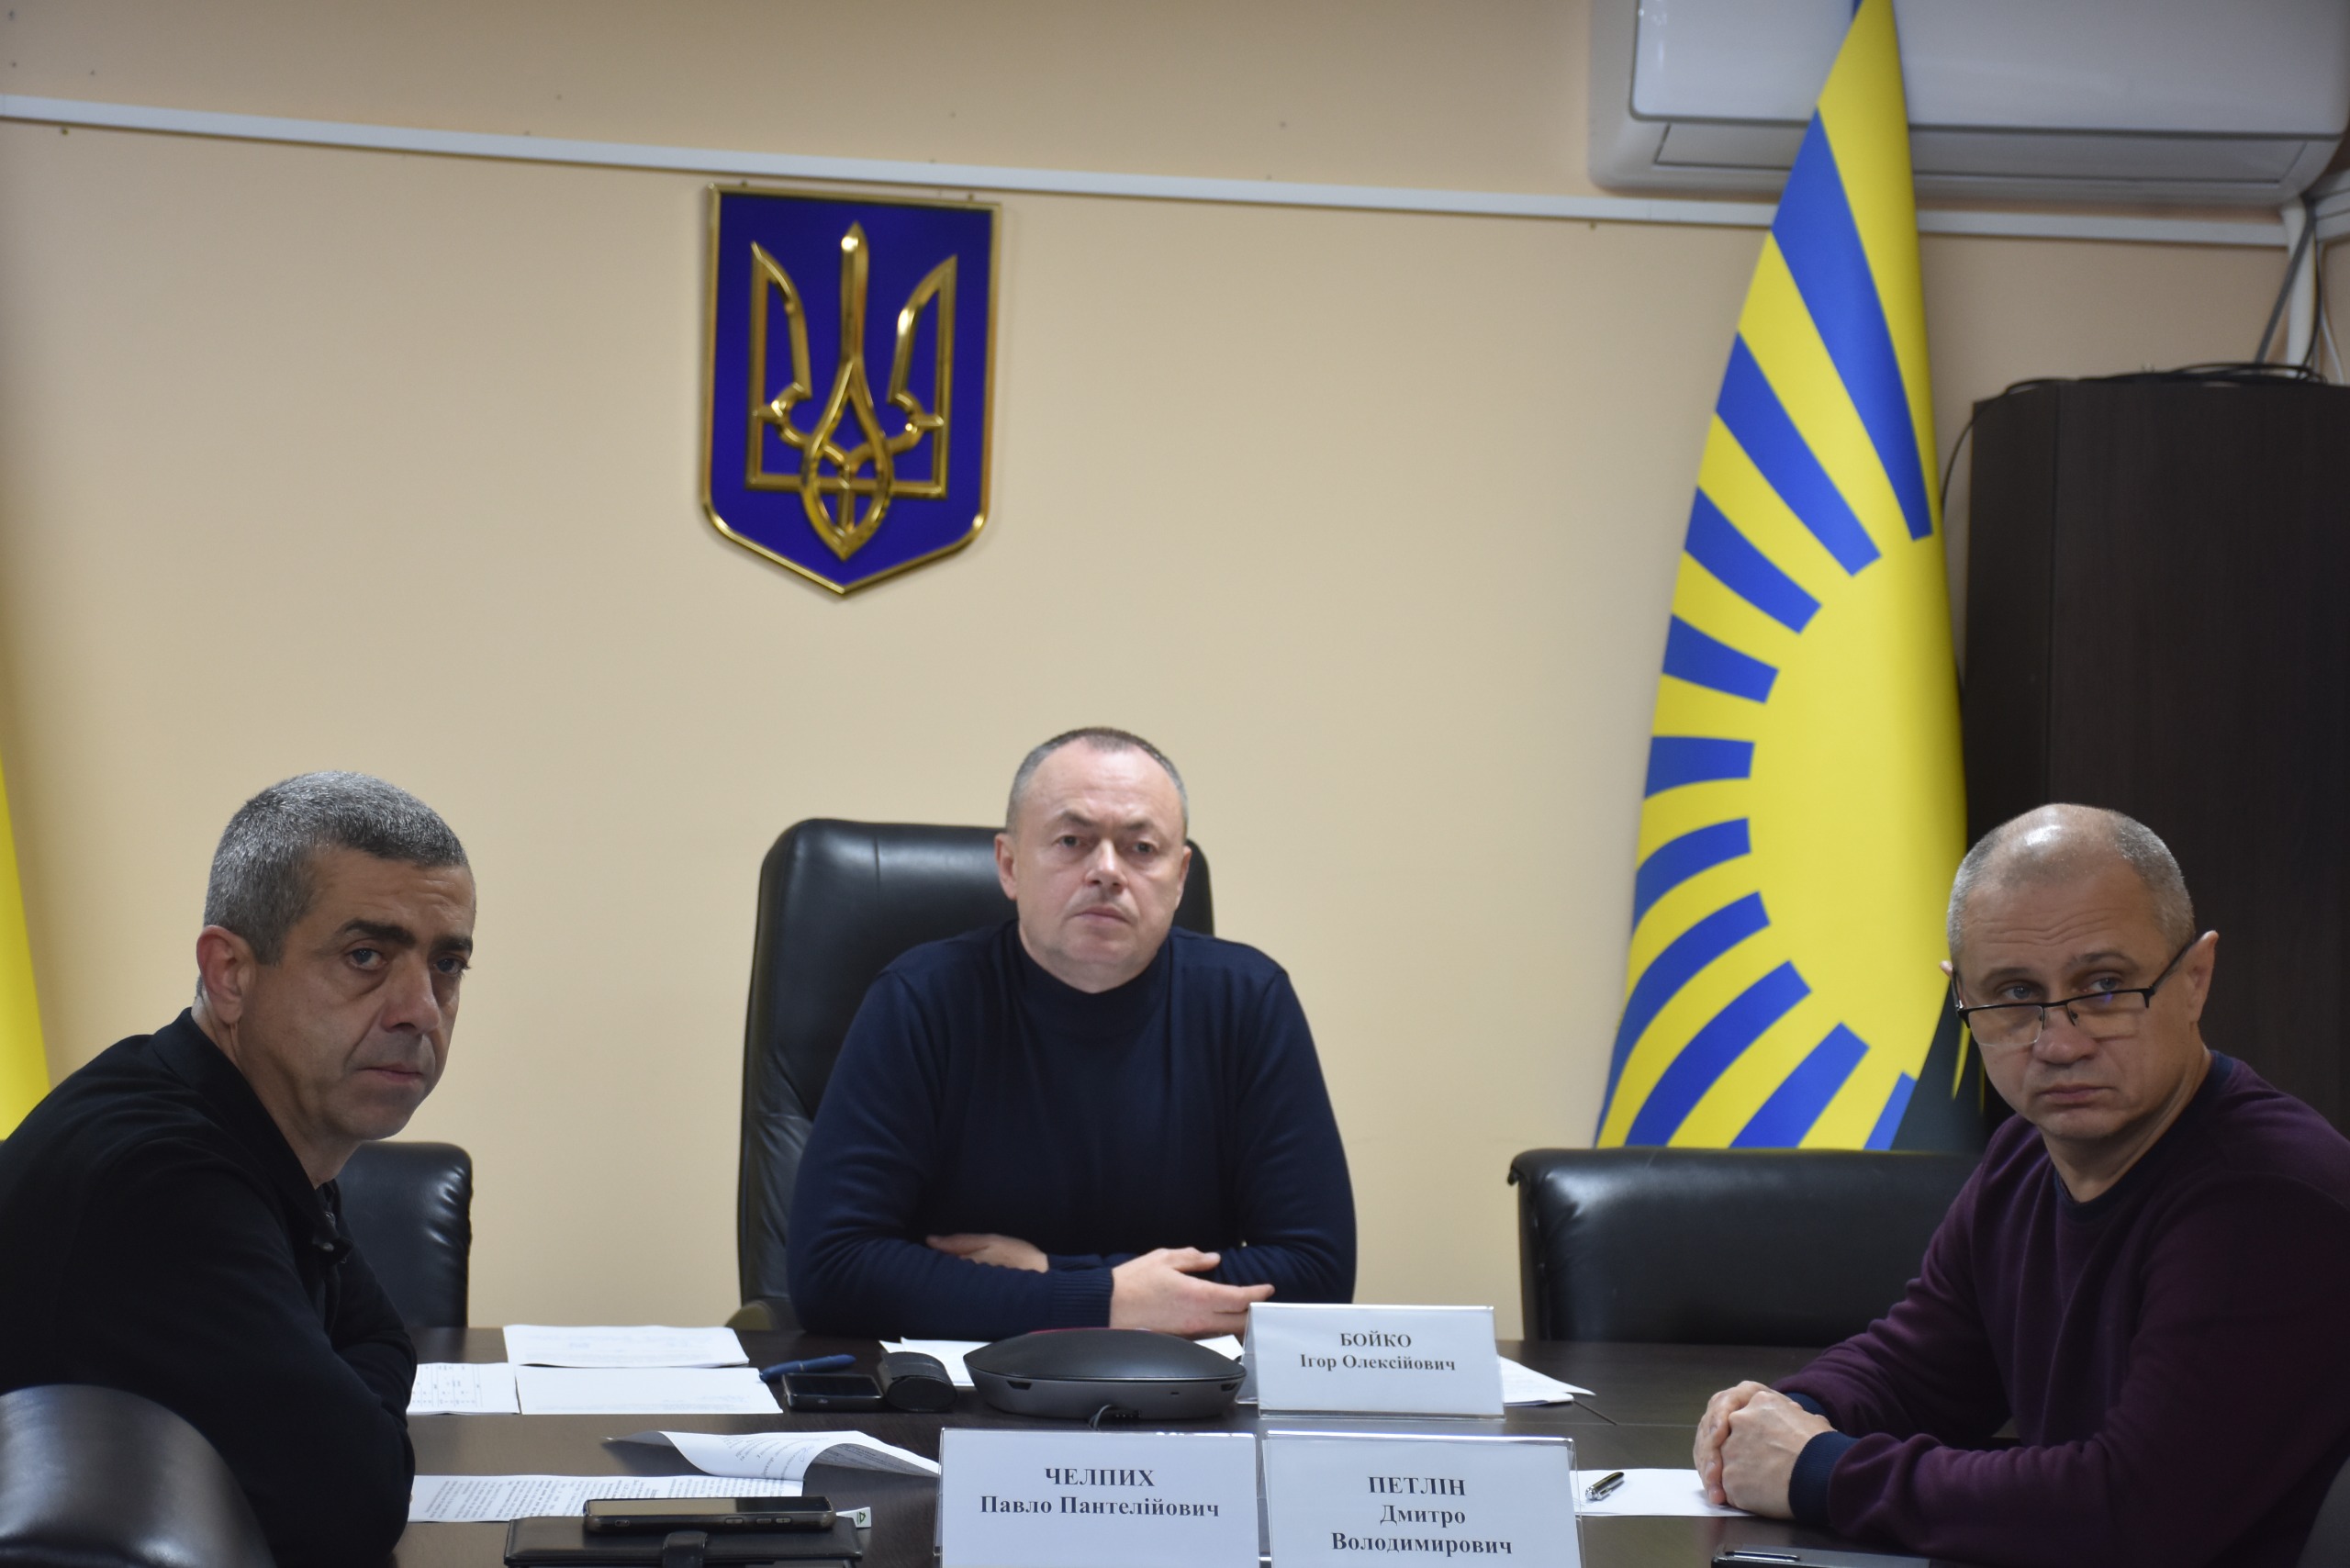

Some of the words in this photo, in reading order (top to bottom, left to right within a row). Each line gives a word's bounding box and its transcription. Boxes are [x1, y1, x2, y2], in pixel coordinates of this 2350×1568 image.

[1340, 1330, 1412, 1348] БОЙКО
[1300, 1353, 1337, 1372] Ігор
[1342, 1354, 1456, 1372] Олексійович
[1045, 1468, 1156, 1487] ЧЕЛПИХ
[1367, 1476, 1466, 1496] ПЕТЛІН
[980, 1495, 1053, 1514] Павло
[1059, 1495, 1220, 1518] Пантелійович
[1379, 1505, 1467, 1529] Дмитро
[1330, 1532, 1514, 1558] Володимирович
